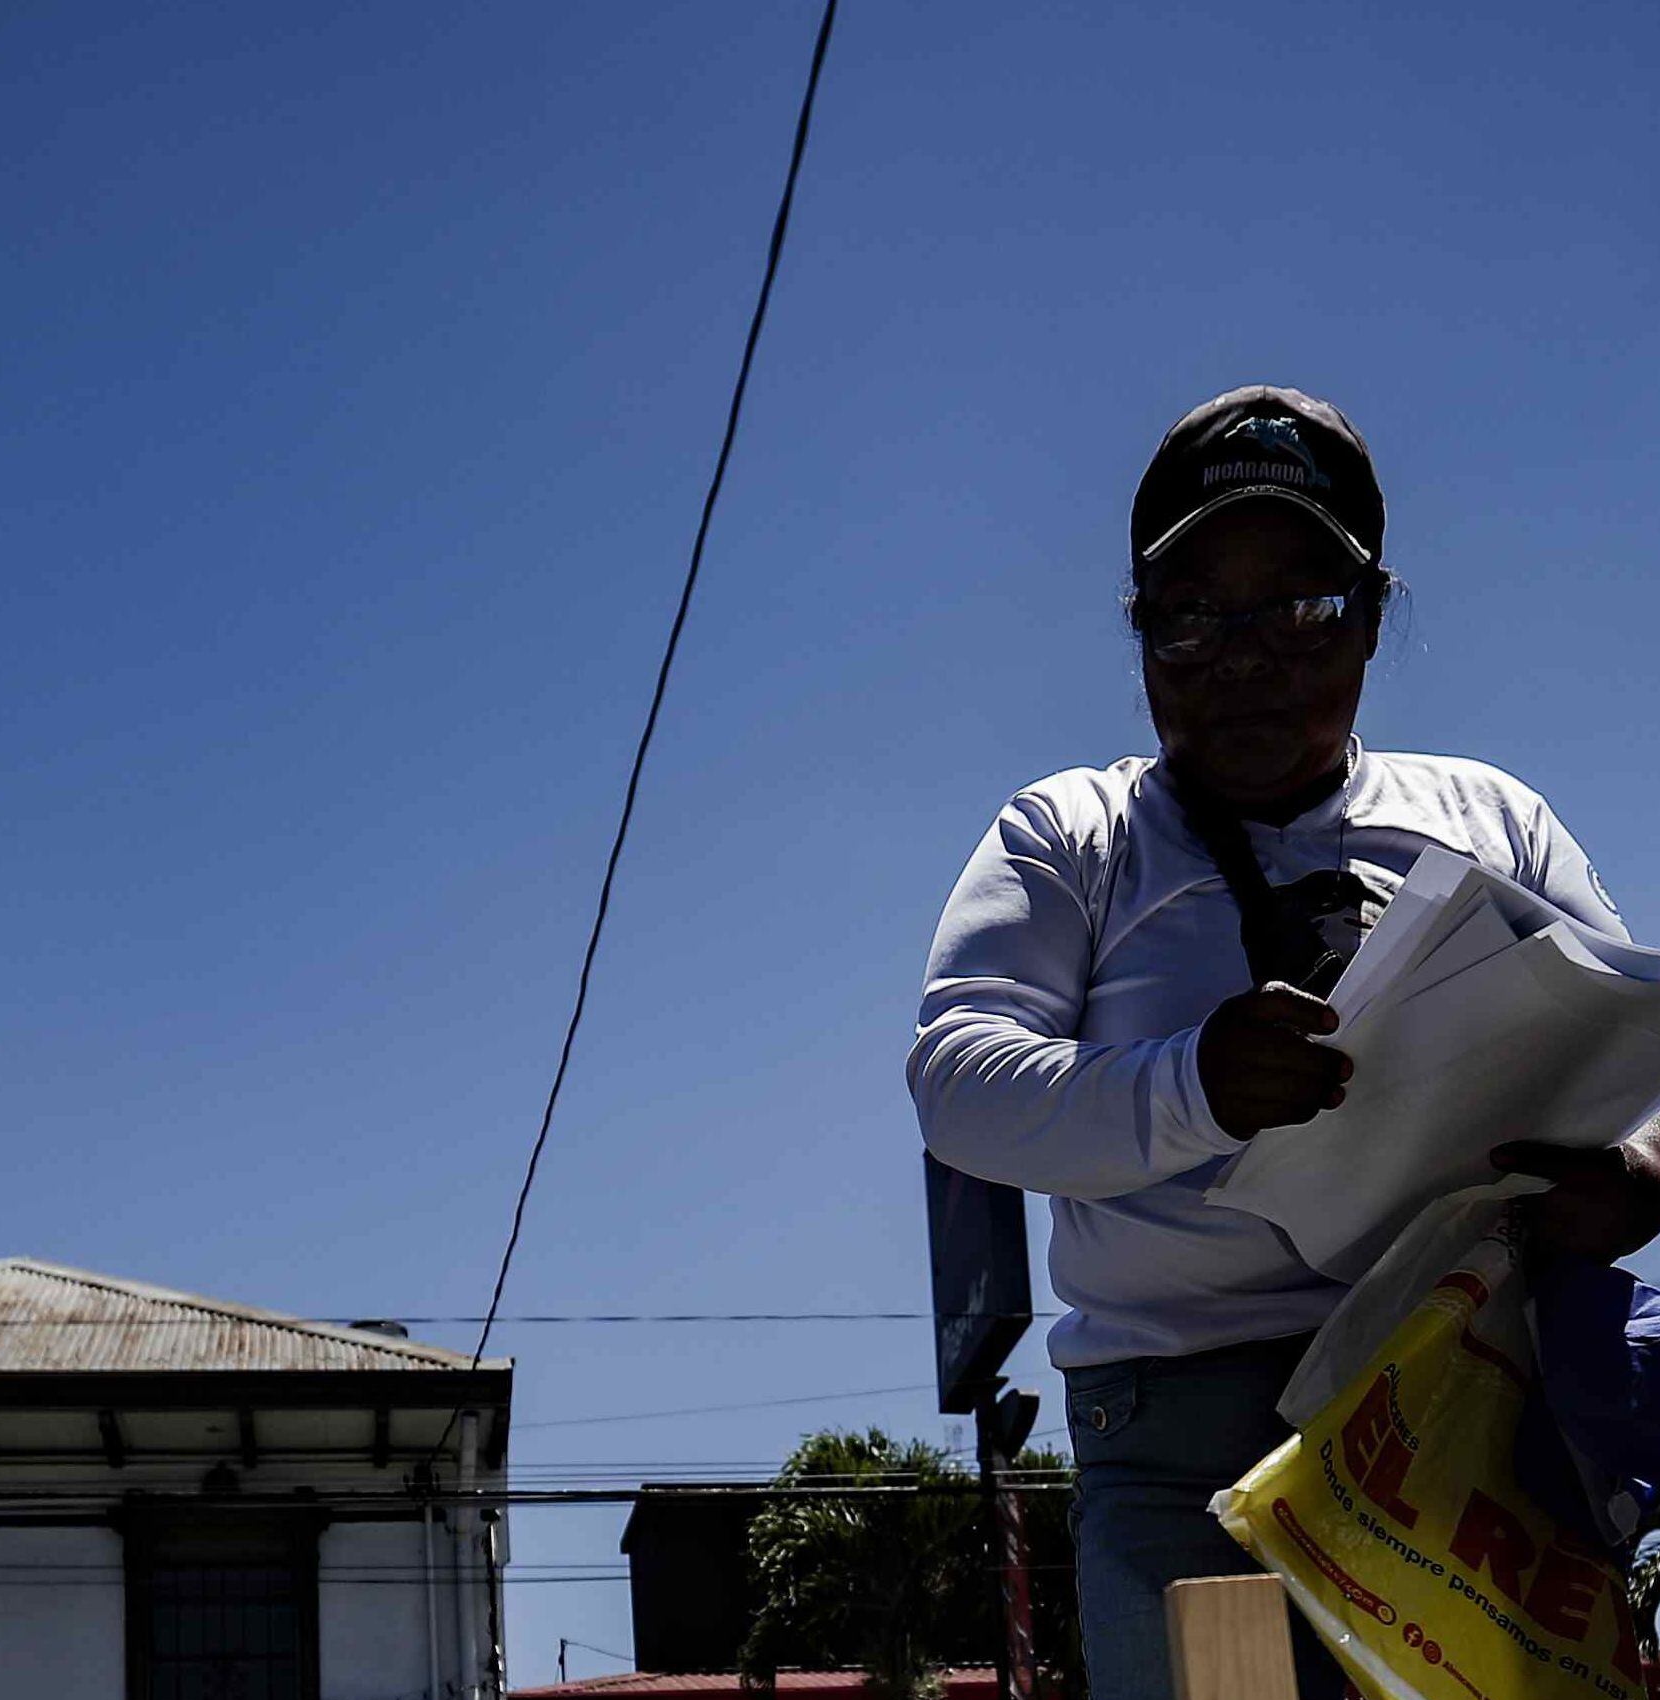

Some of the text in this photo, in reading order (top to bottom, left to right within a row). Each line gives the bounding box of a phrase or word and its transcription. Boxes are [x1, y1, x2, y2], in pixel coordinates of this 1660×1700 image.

[1203, 460, 1304, 487] NICARAGUA
[1342, 1372, 1420, 1530] EL
[1320, 1438, 1354, 1512] Donde
[1358, 1512, 1445, 1577] siempre
[1448, 1573, 1553, 1662] pensamos
[1559, 1654, 1589, 1681] en
